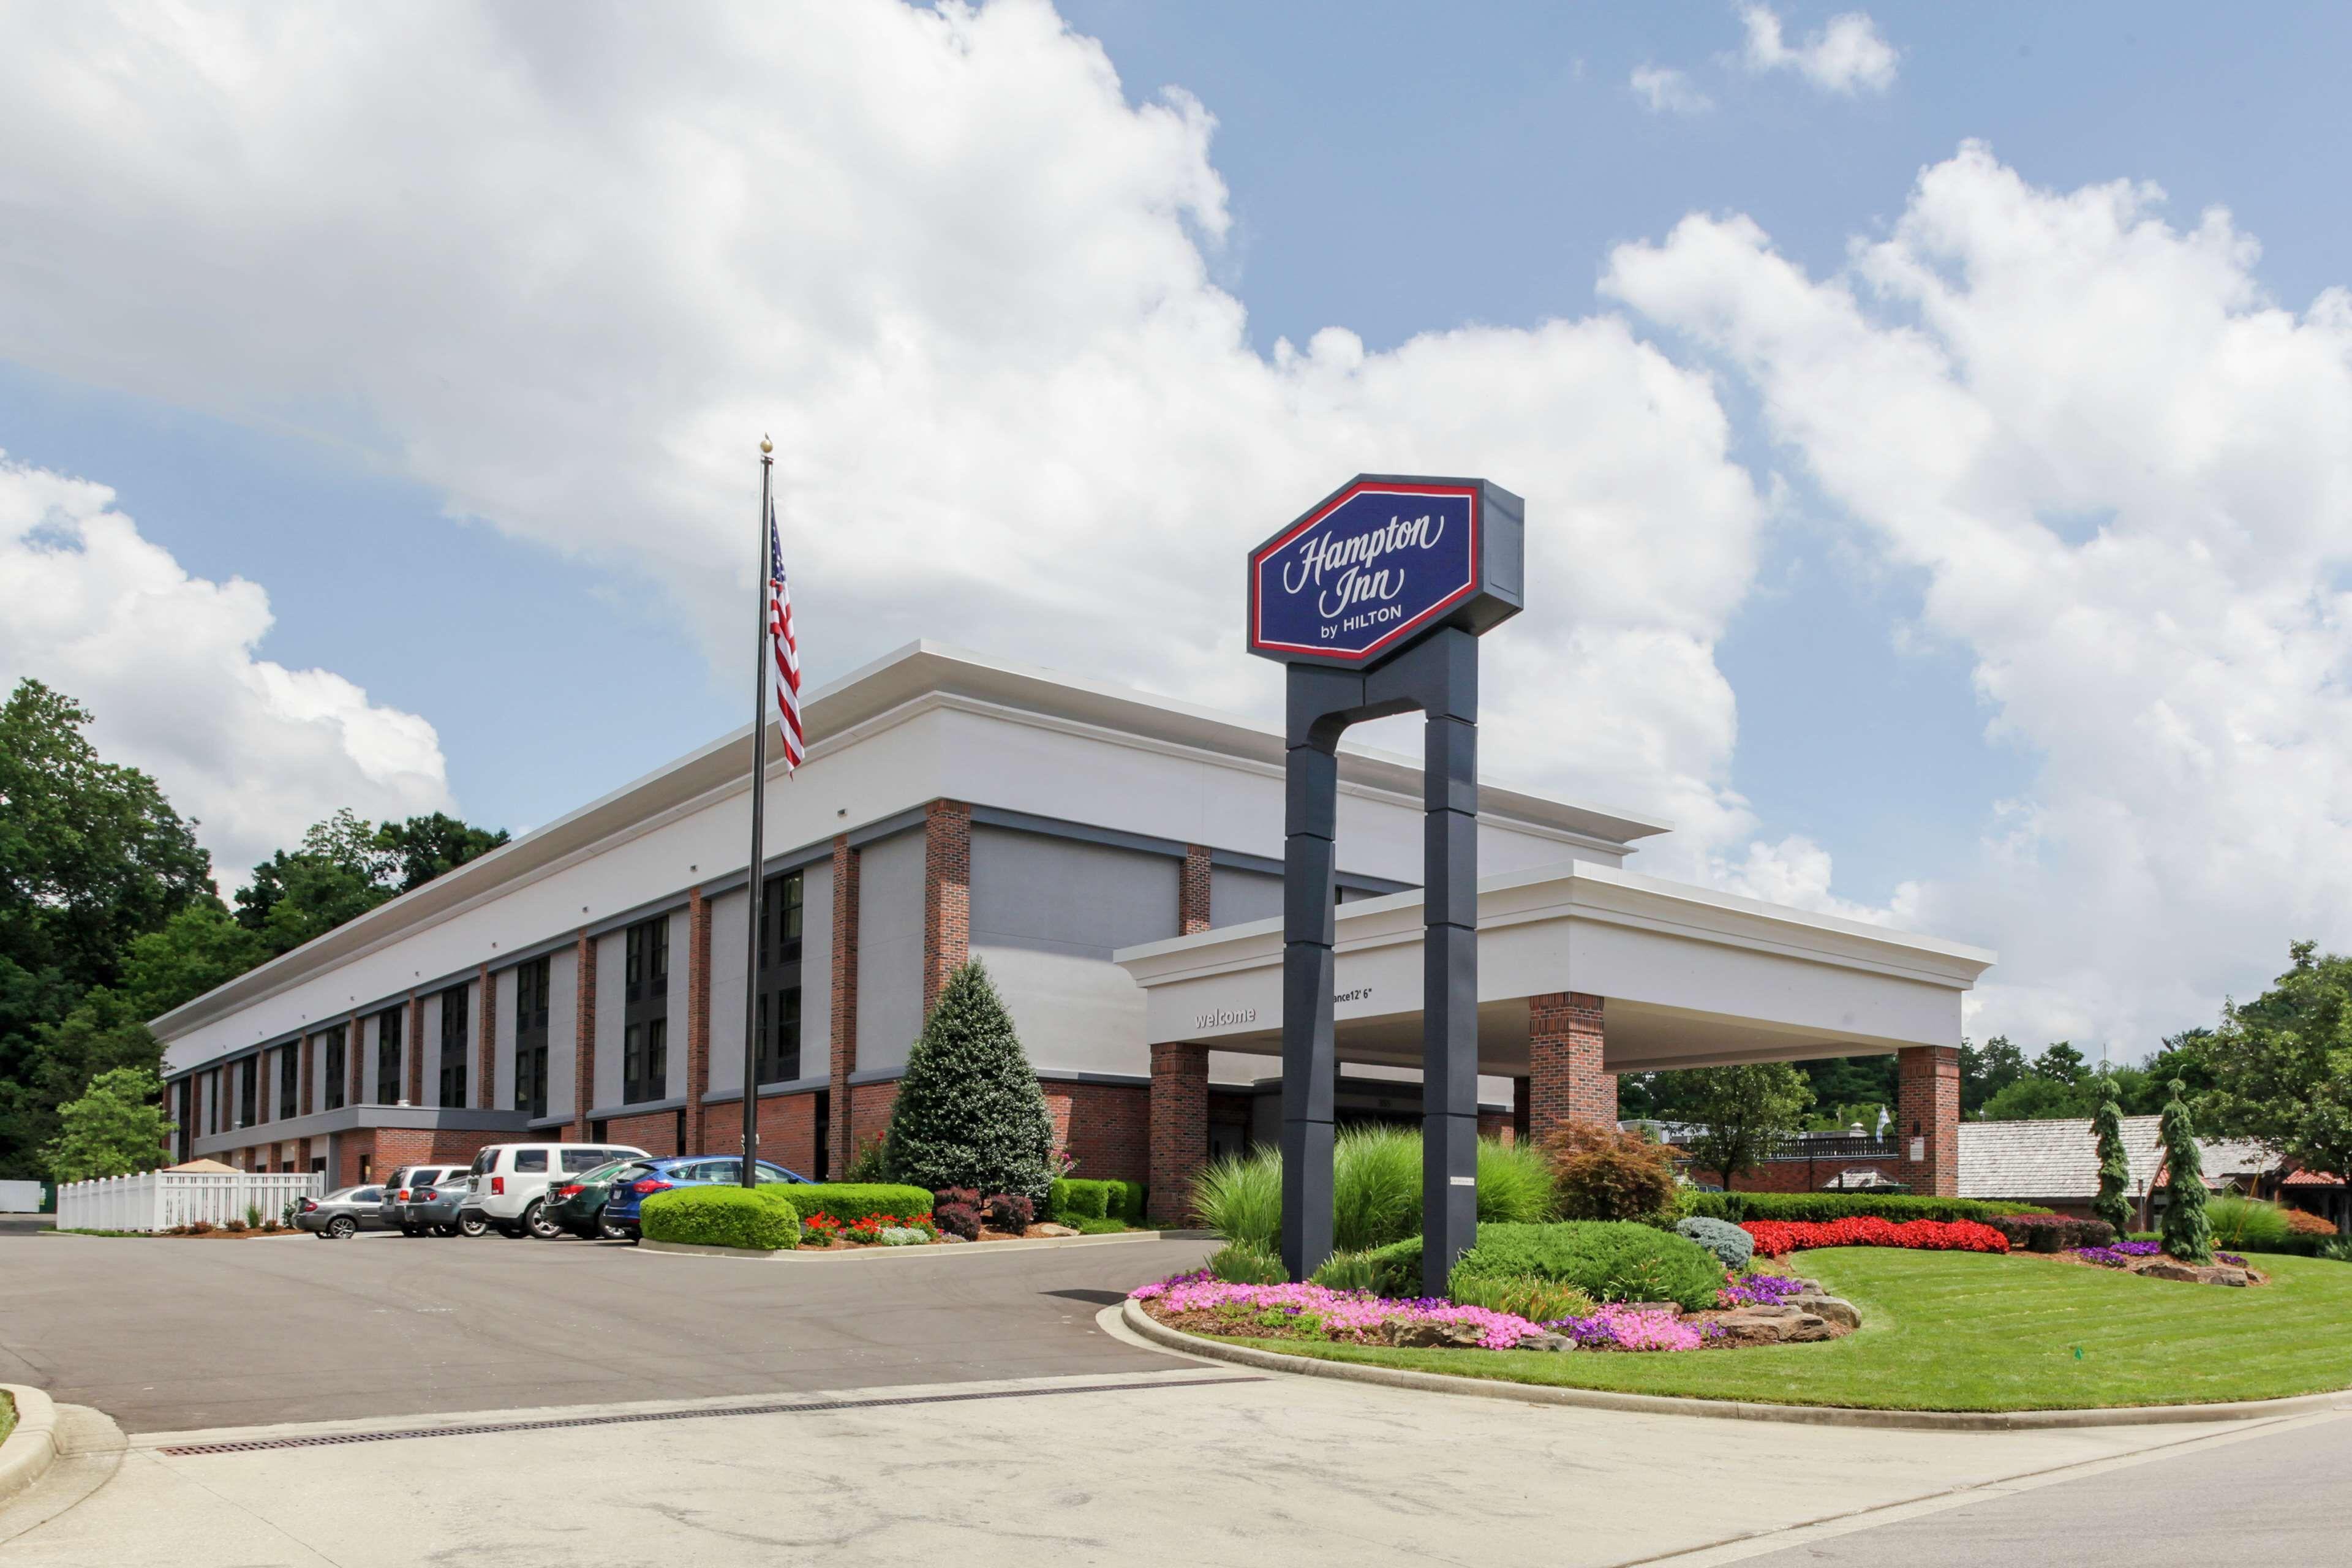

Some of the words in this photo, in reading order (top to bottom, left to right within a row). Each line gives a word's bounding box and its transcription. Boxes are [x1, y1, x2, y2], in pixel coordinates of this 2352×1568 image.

[1283, 515, 1445, 594] Hampton
[1319, 566, 1404, 618] Inn
[1321, 625, 1338, 639] by
[1343, 605, 1401, 632] HILTON
[1196, 1008, 1256, 1029] welcome
